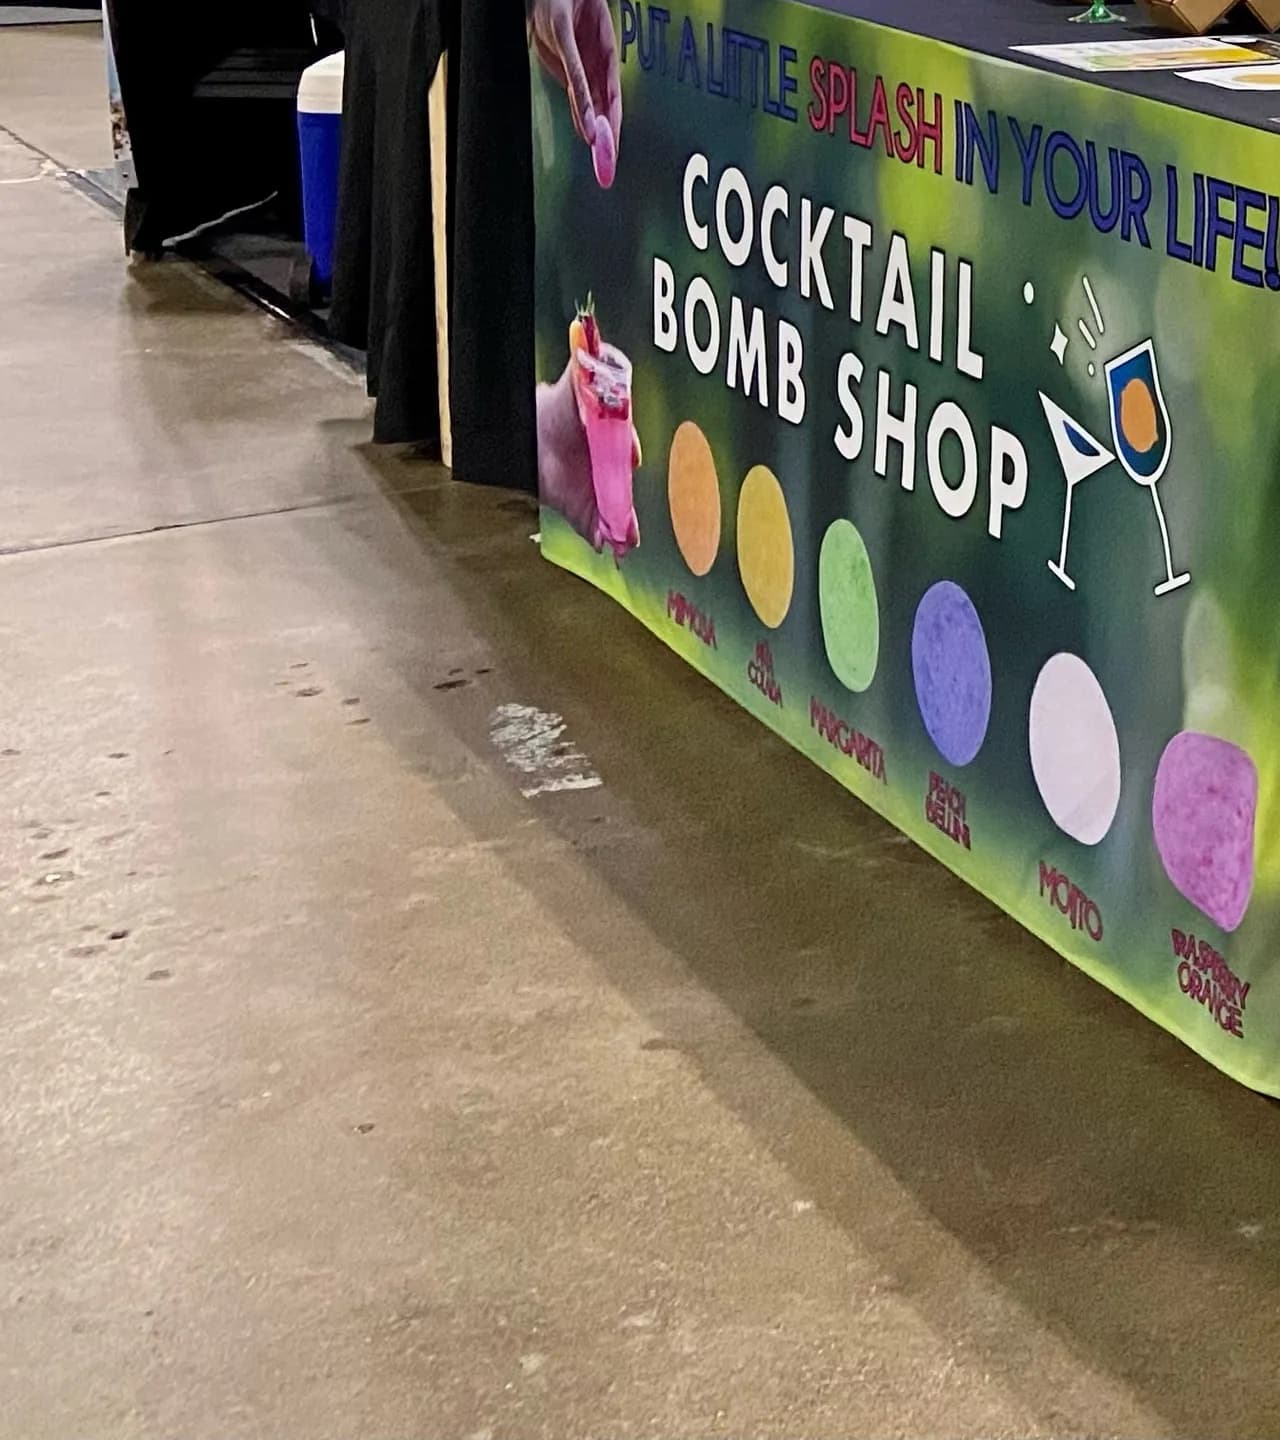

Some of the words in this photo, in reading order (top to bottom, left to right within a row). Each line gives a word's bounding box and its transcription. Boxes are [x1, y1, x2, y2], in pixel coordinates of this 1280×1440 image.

[679, 16, 700, 89] A
[706, 22, 798, 123] LITTLE
[807, 56, 943, 176] SPLASH
[954, 100, 999, 194] IN
[1007, 116, 1152, 249] YOUR
[682, 152, 985, 381] COCKTAIL
[652, 256, 806, 426] BOMB
[833, 351, 1029, 540] SHOP
[1039, 859, 1104, 942] MOJITO
